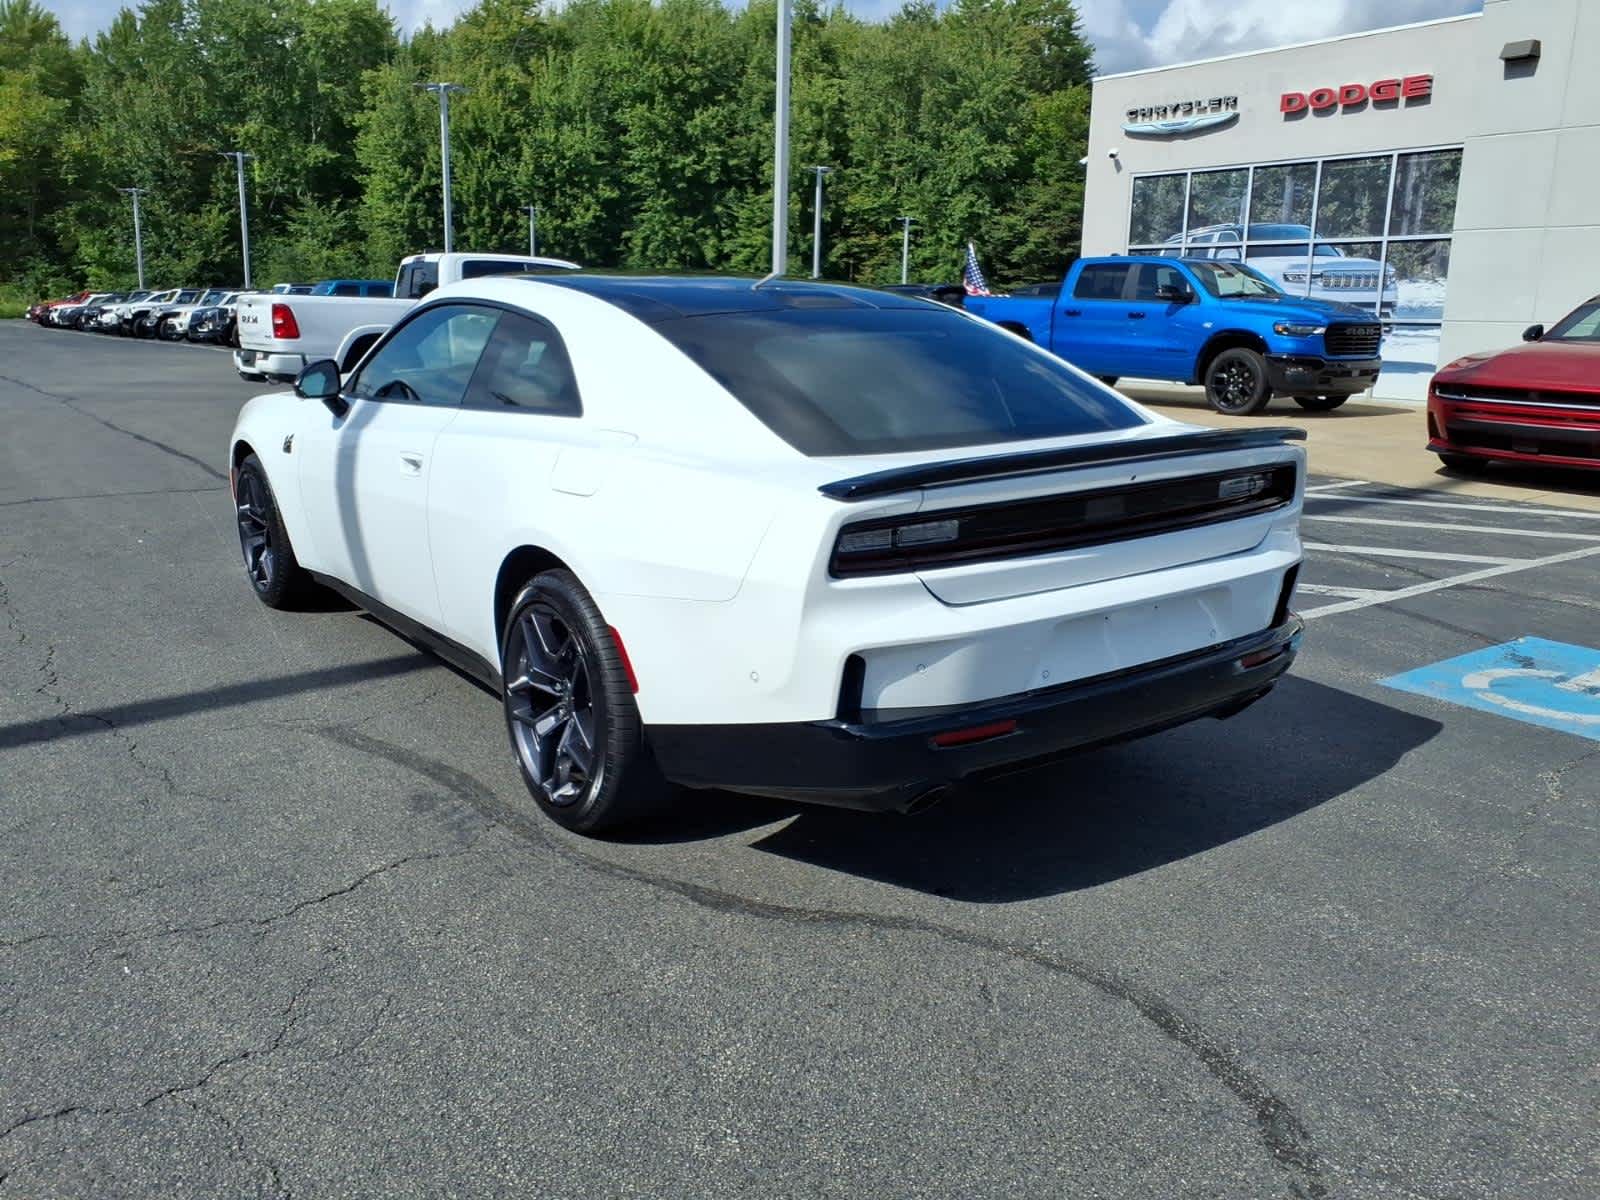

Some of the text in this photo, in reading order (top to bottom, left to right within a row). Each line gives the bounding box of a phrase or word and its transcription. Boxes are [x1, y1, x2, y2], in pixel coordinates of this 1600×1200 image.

[1280, 74, 1433, 113] DODGE
[1126, 96, 1238, 119] CHRYSLER
[241, 315, 258, 324] RAM
